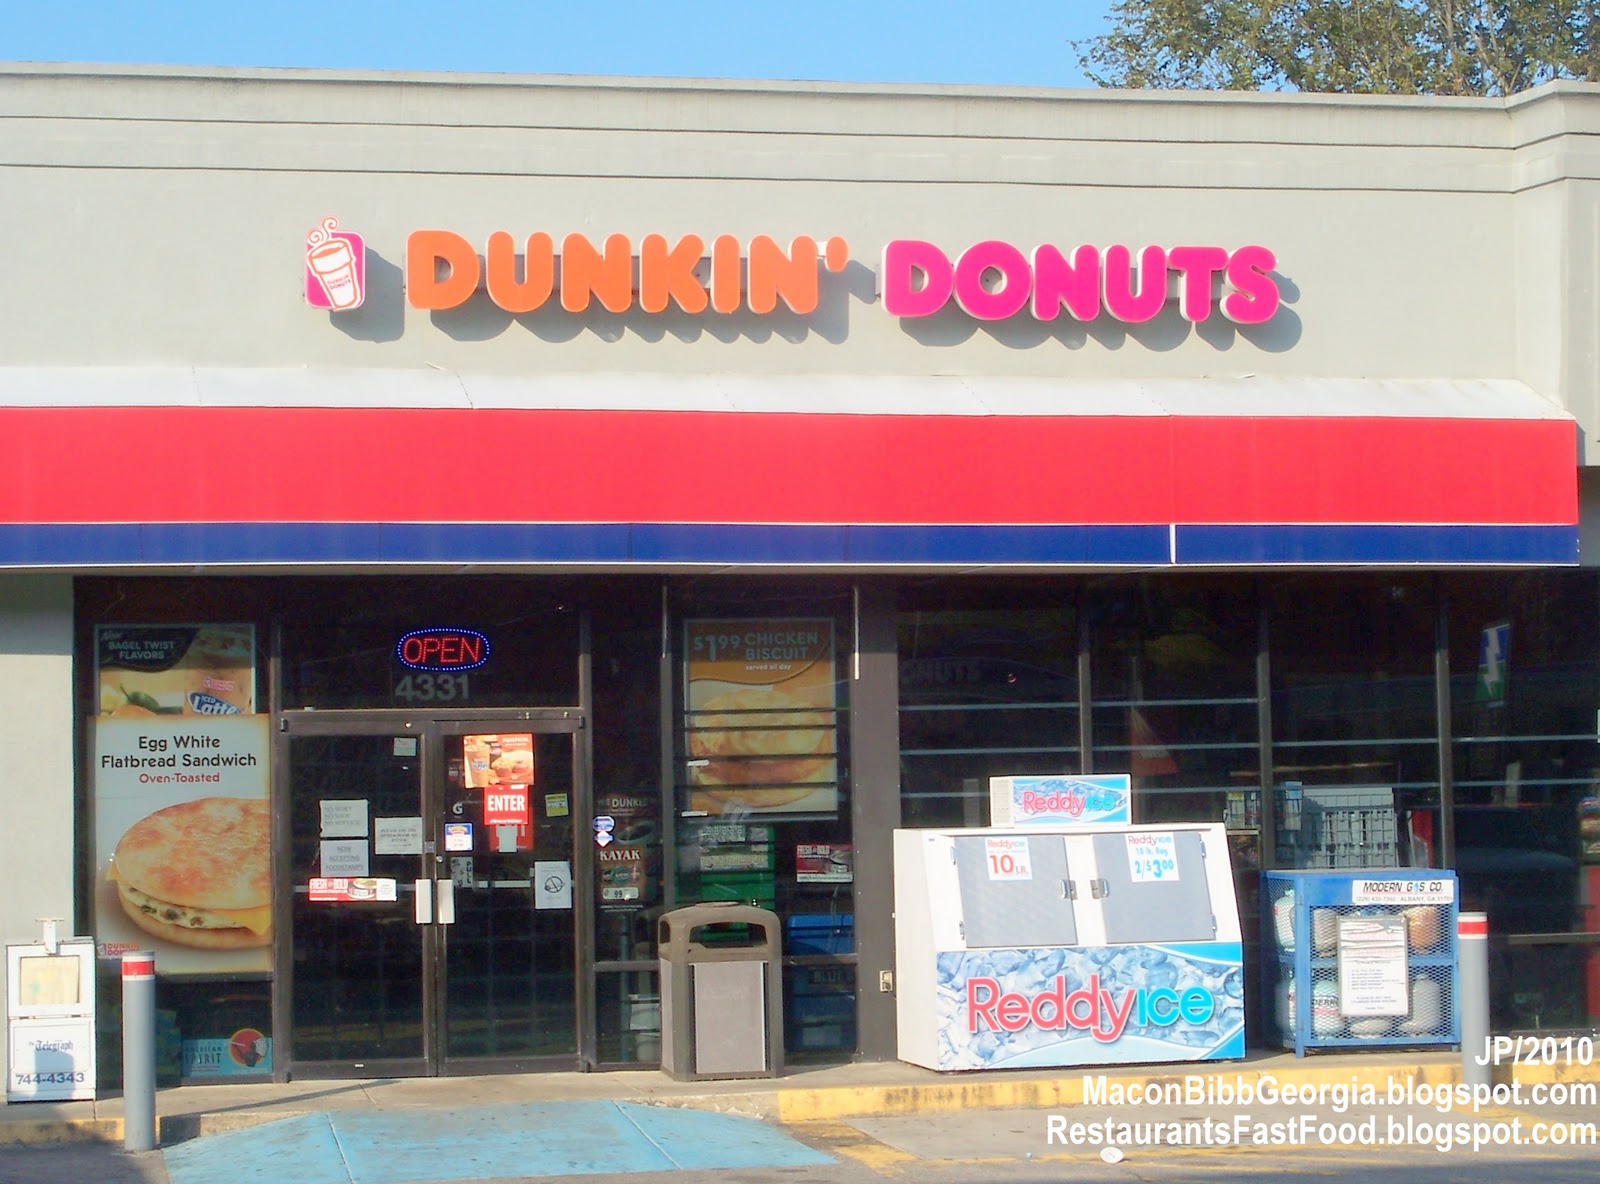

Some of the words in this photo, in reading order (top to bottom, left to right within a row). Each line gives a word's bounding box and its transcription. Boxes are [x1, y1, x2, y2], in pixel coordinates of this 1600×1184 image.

[406, 229, 848, 314] DUNKIN'
[881, 240, 1280, 324] DONUTS
[108, 641, 141, 650] BAGEL
[144, 641, 175, 650] TWIST
[744, 632, 818, 646] CHICKEN
[119, 651, 165, 660] FLAVORS
[402, 637, 481, 663] OPEN
[745, 647, 809, 660] BISCUIT
[745, 663, 769, 671] served
[779, 663, 792, 672] day
[394, 674, 469, 701] 4331
[138, 736, 168, 752] Egg
[173, 735, 221, 748] White
[101, 754, 176, 769] Flatbread
[182, 753, 257, 768] Sandwich
[139, 772, 220, 784] Oven-Toasted
[487, 794, 525, 812] ENTER
[600, 850, 641, 861] KAYAK
[989, 854, 1014, 874] 10
[1363, 882, 1403, 892] MODERN
[35, 1039, 74, 1053] Telegraph
[15, 1072, 85, 1085] 744-4343
